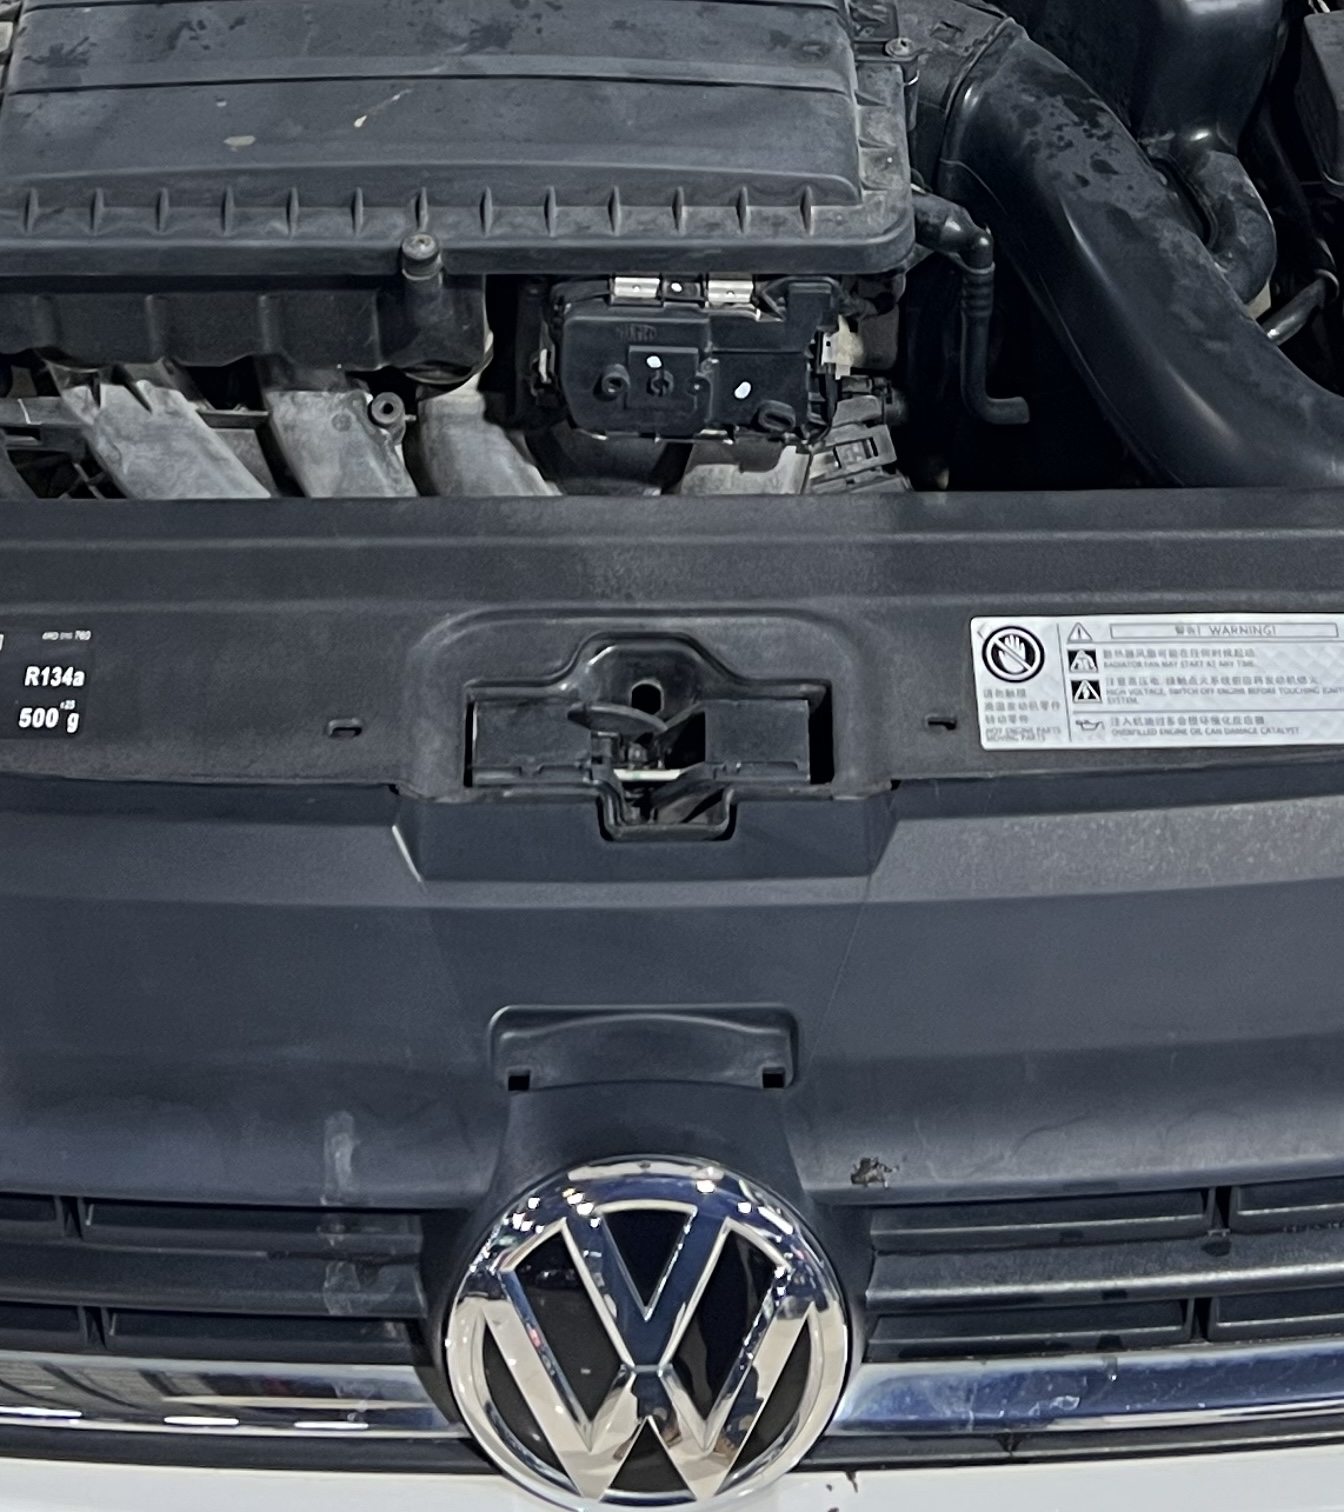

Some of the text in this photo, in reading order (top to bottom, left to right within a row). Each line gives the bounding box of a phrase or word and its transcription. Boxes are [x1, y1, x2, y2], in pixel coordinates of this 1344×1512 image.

[1208, 624, 1277, 636] WARNING!
[24, 666, 86, 687] R134a
[18, 707, 60, 728] 500
[66, 713, 80, 733] g
